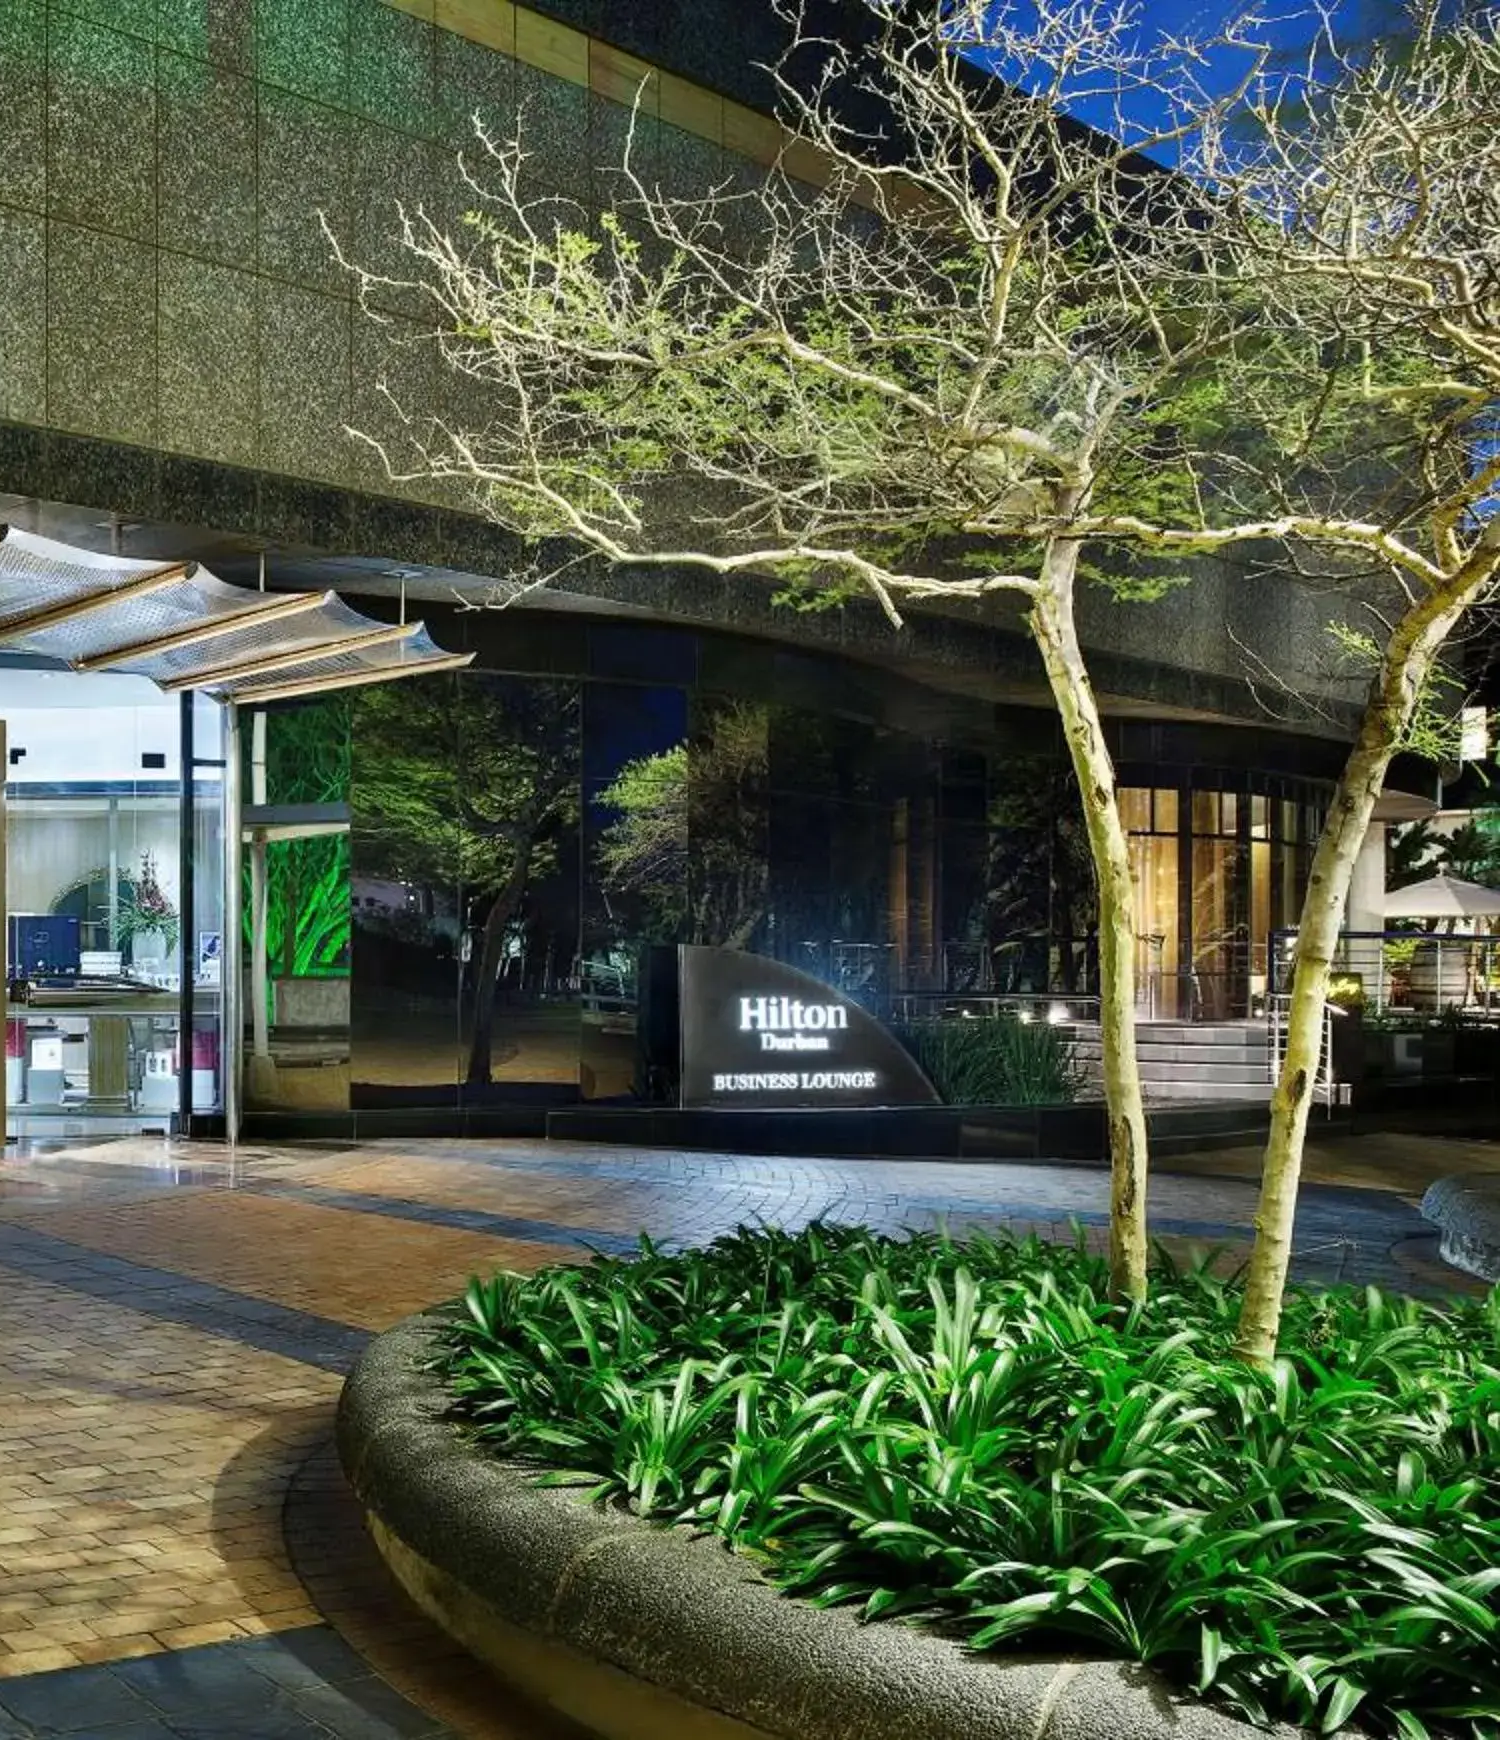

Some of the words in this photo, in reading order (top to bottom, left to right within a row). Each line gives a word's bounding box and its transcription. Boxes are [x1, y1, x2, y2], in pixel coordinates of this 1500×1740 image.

[739, 997, 848, 1030] Hilton
[761, 1033, 829, 1051] Durban
[713, 1073, 798, 1091] BUSINESS
[801, 1071, 877, 1089] LOUNGE
